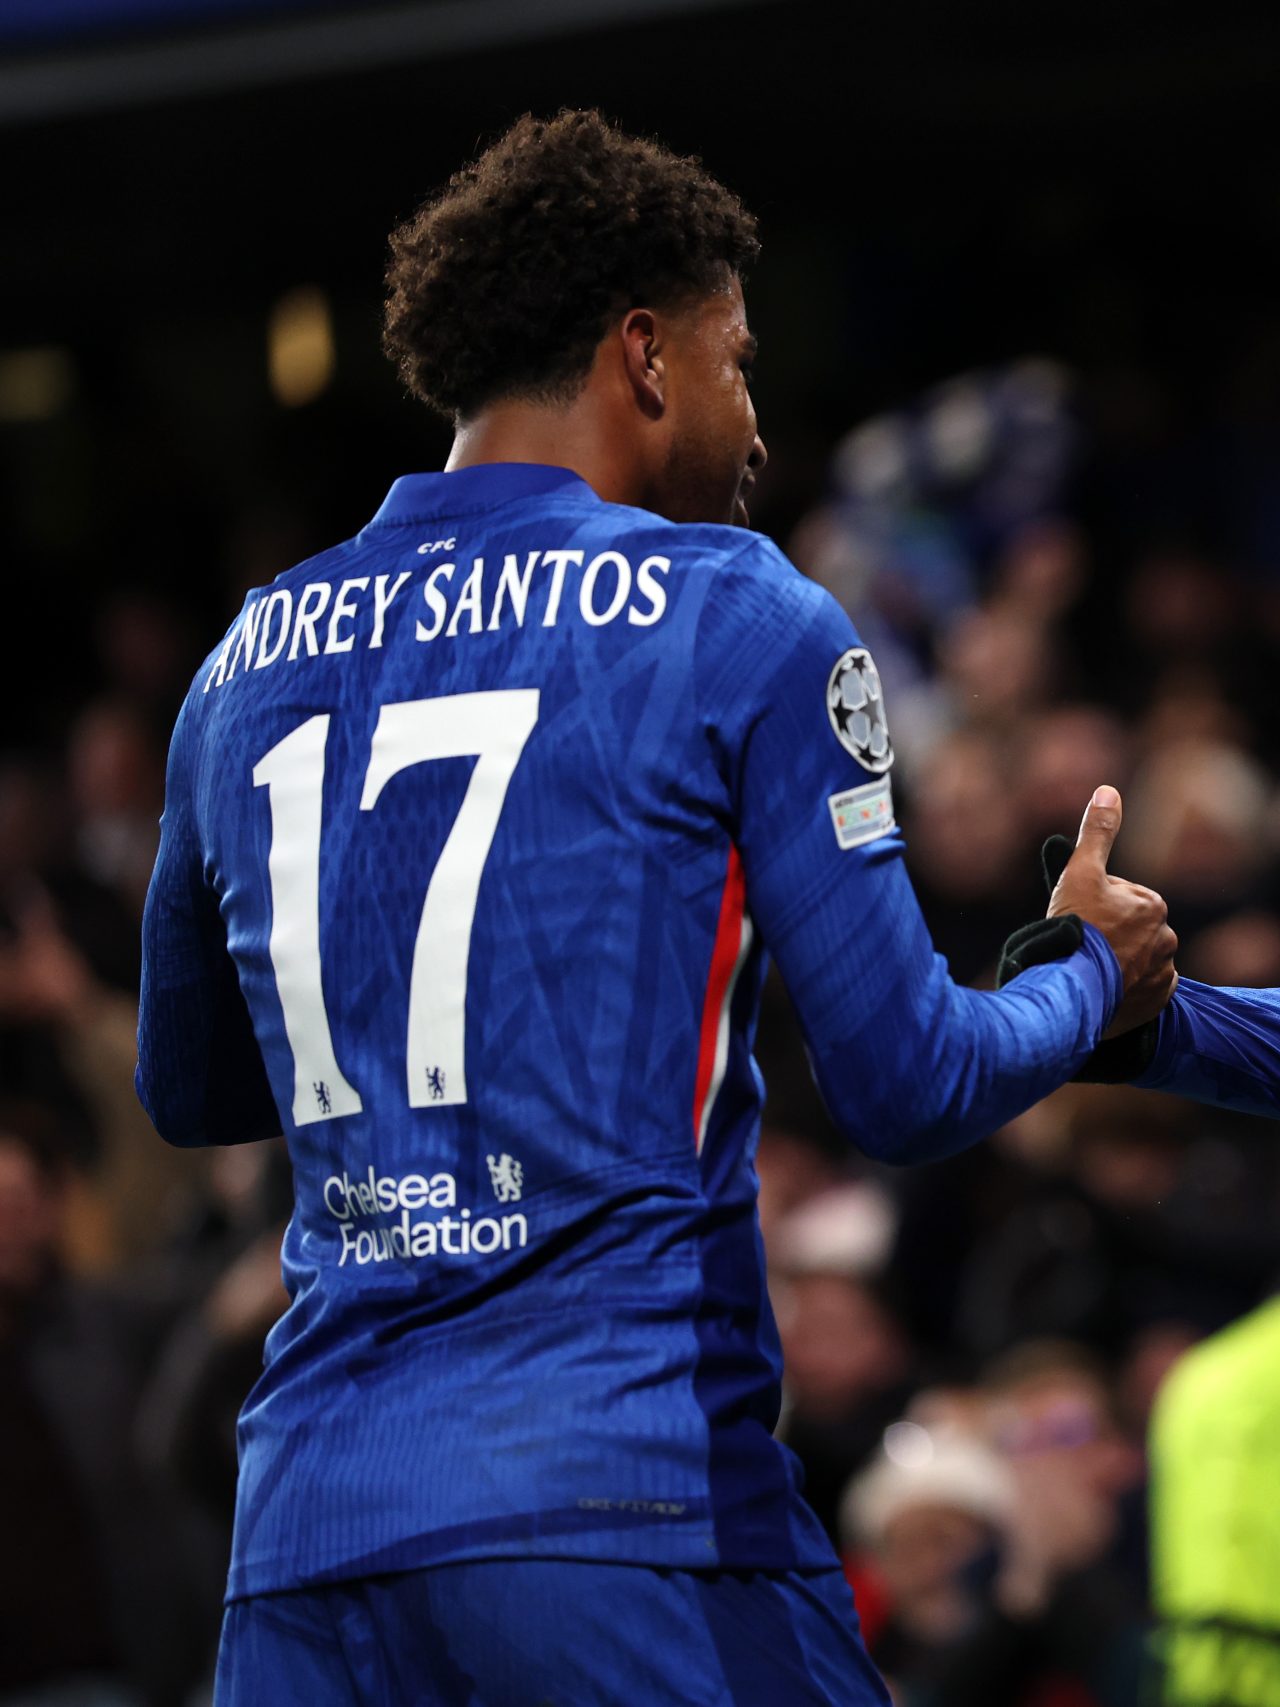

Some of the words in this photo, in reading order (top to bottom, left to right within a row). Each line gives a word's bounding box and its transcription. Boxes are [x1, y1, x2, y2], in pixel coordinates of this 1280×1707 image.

[417, 537, 457, 554] CFC
[203, 571, 412, 693] ANDREY
[415, 550, 672, 642] SANTOS
[253, 688, 540, 1127] 17
[323, 1165, 456, 1220] Chelsea
